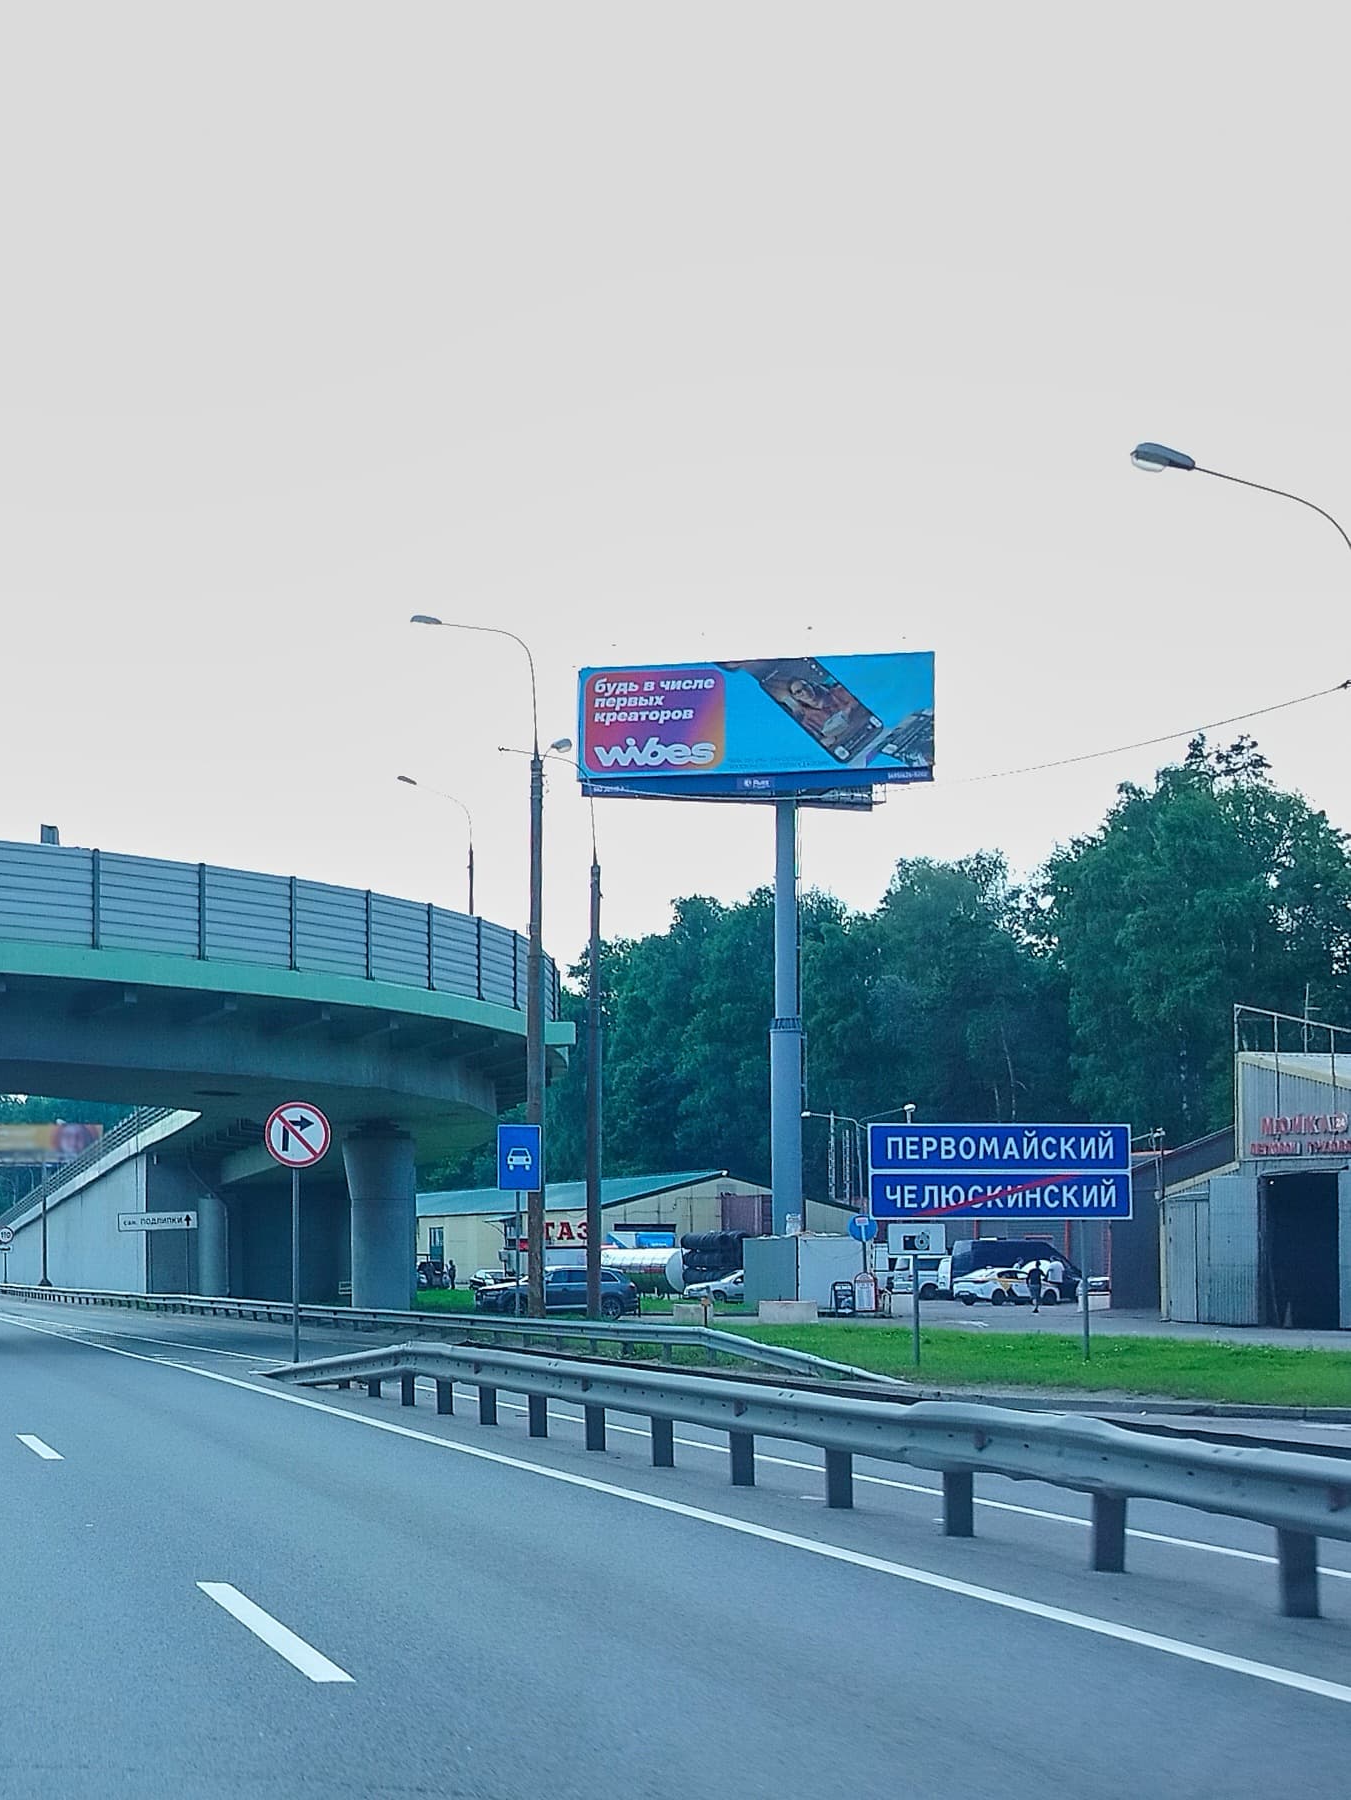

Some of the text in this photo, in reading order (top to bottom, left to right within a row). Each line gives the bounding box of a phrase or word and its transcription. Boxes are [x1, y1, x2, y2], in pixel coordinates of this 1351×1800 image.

[594, 677, 716, 697] будь в числе
[593, 695, 666, 711] первых
[593, 708, 695, 727] креаторов
[593, 736, 717, 767] wibes
[886, 1129, 1115, 1161] ПЕРВОМАЙСКИЙ
[885, 1178, 1117, 1209] ЧЕЛЮСКИНСКИЙ
